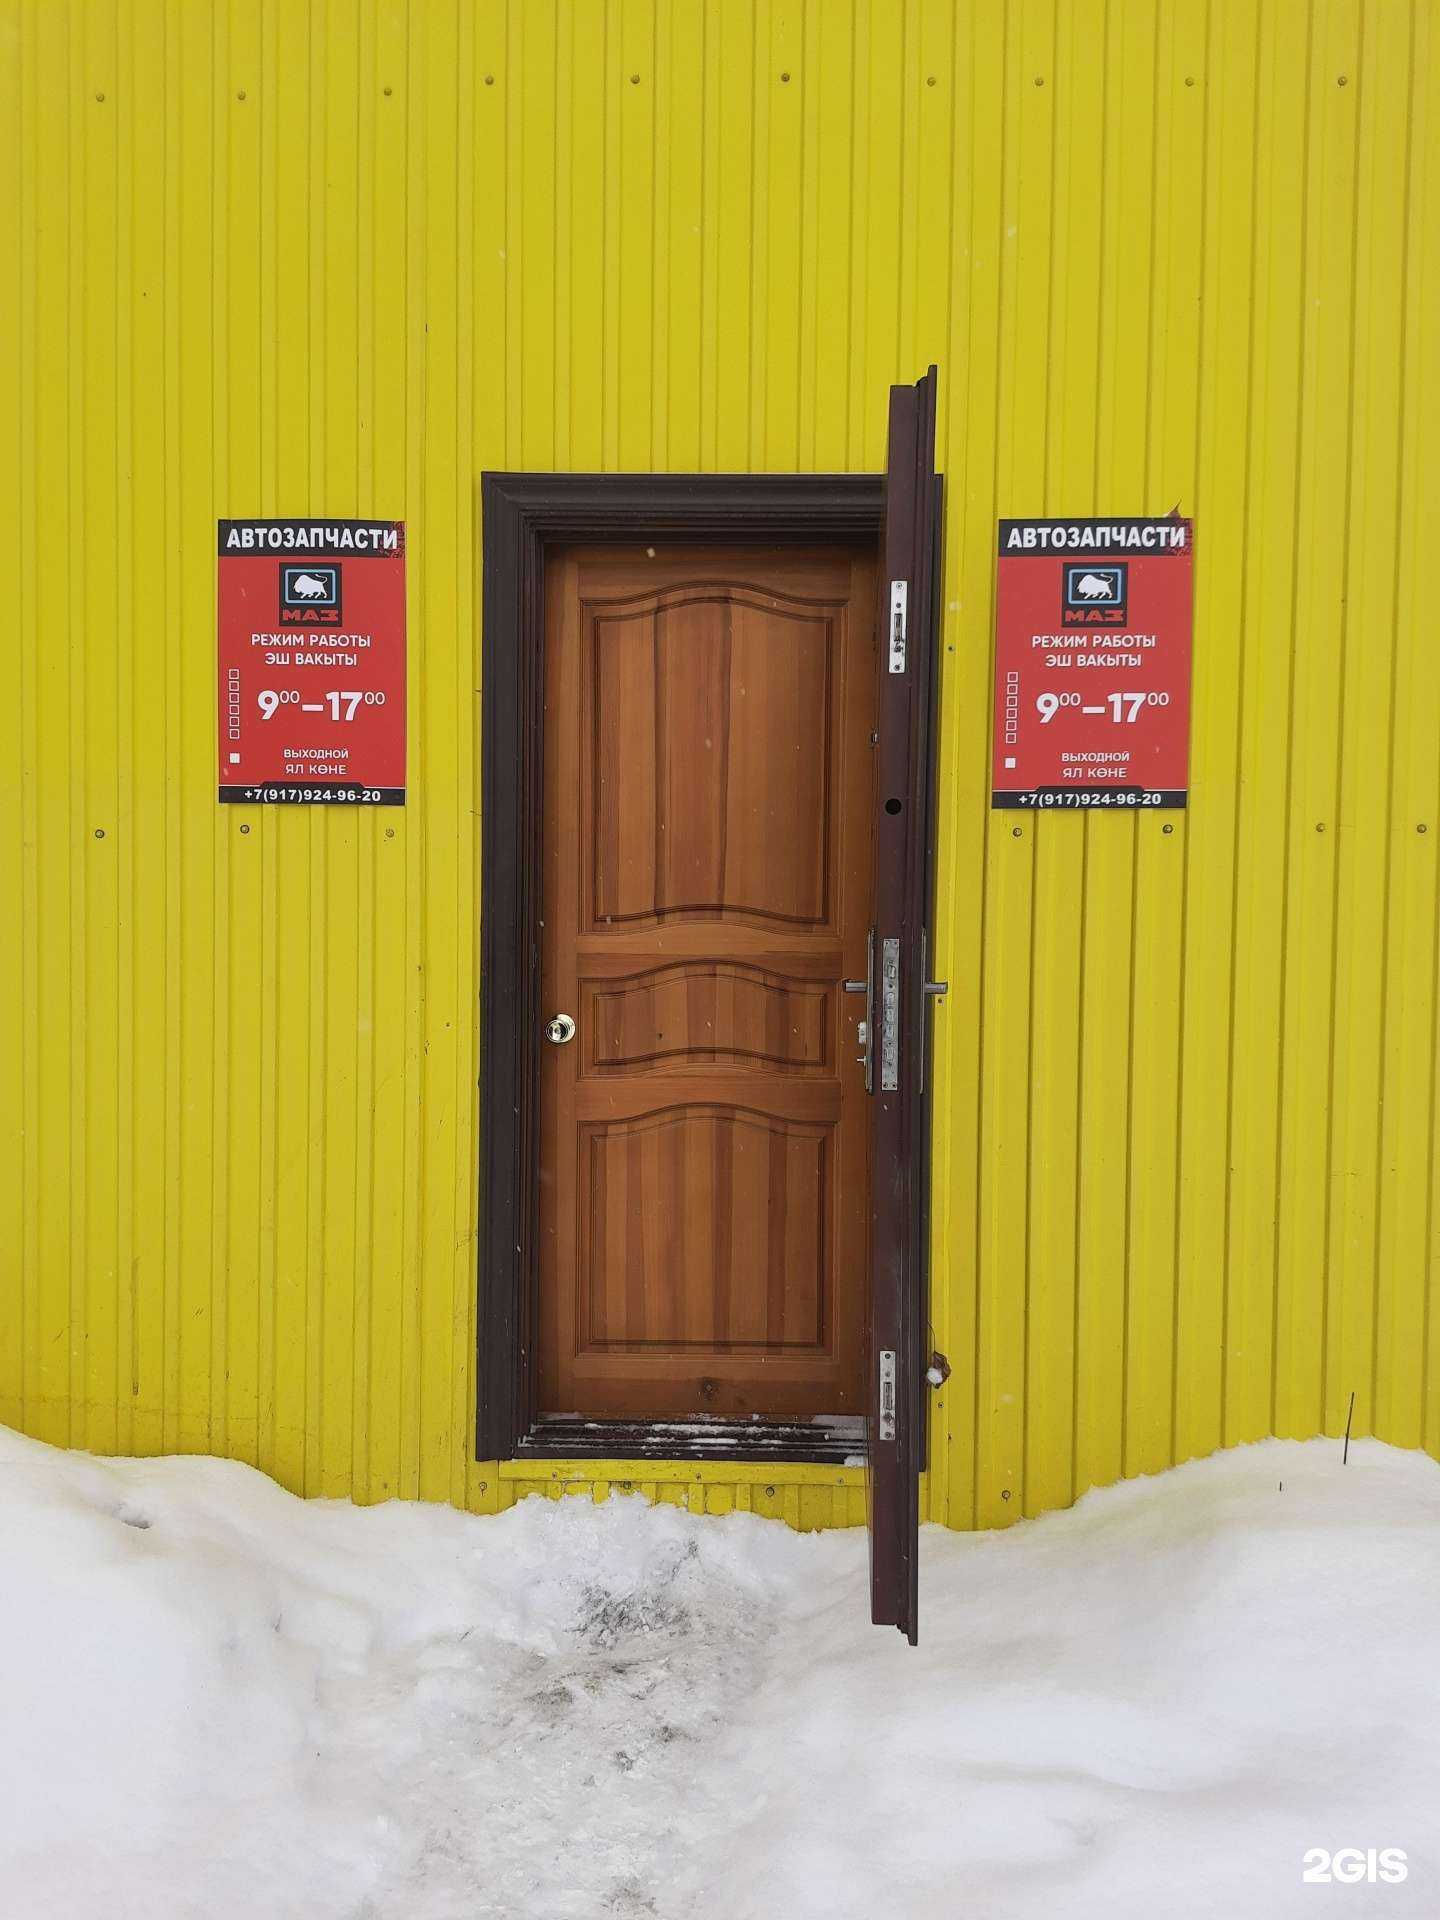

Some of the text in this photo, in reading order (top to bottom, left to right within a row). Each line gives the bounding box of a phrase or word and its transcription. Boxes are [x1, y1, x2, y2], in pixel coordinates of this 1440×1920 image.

[226, 527, 398, 549] АВТОЗАПЧАСТИ
[1007, 526, 1185, 548] АВТОЗАПЧАСТИ
[282, 609, 338, 621] МАЗ
[1065, 609, 1124, 622] МАЗ
[251, 633, 371, 647] РЕЖИМ РАБОТЫ
[1032, 635, 1156, 648] РЕЖИМ РАБОТЫ
[265, 653, 357, 666] ЭШ ВАКЫТЫ
[1045, 654, 1142, 667] ЭШ ВАКЫТЫ
[283, 748, 349, 760] ВЫХОДНОЙ
[1061, 751, 1130, 762] ВЫХОДНОЙ
[285, 764, 304, 774] ЯЛ
[1063, 768, 1083, 778] ЯЛ
[245, 788, 381, 802] +7(917)924-96-20
[1019, 793, 1162, 807] +7(917)924-96-20
